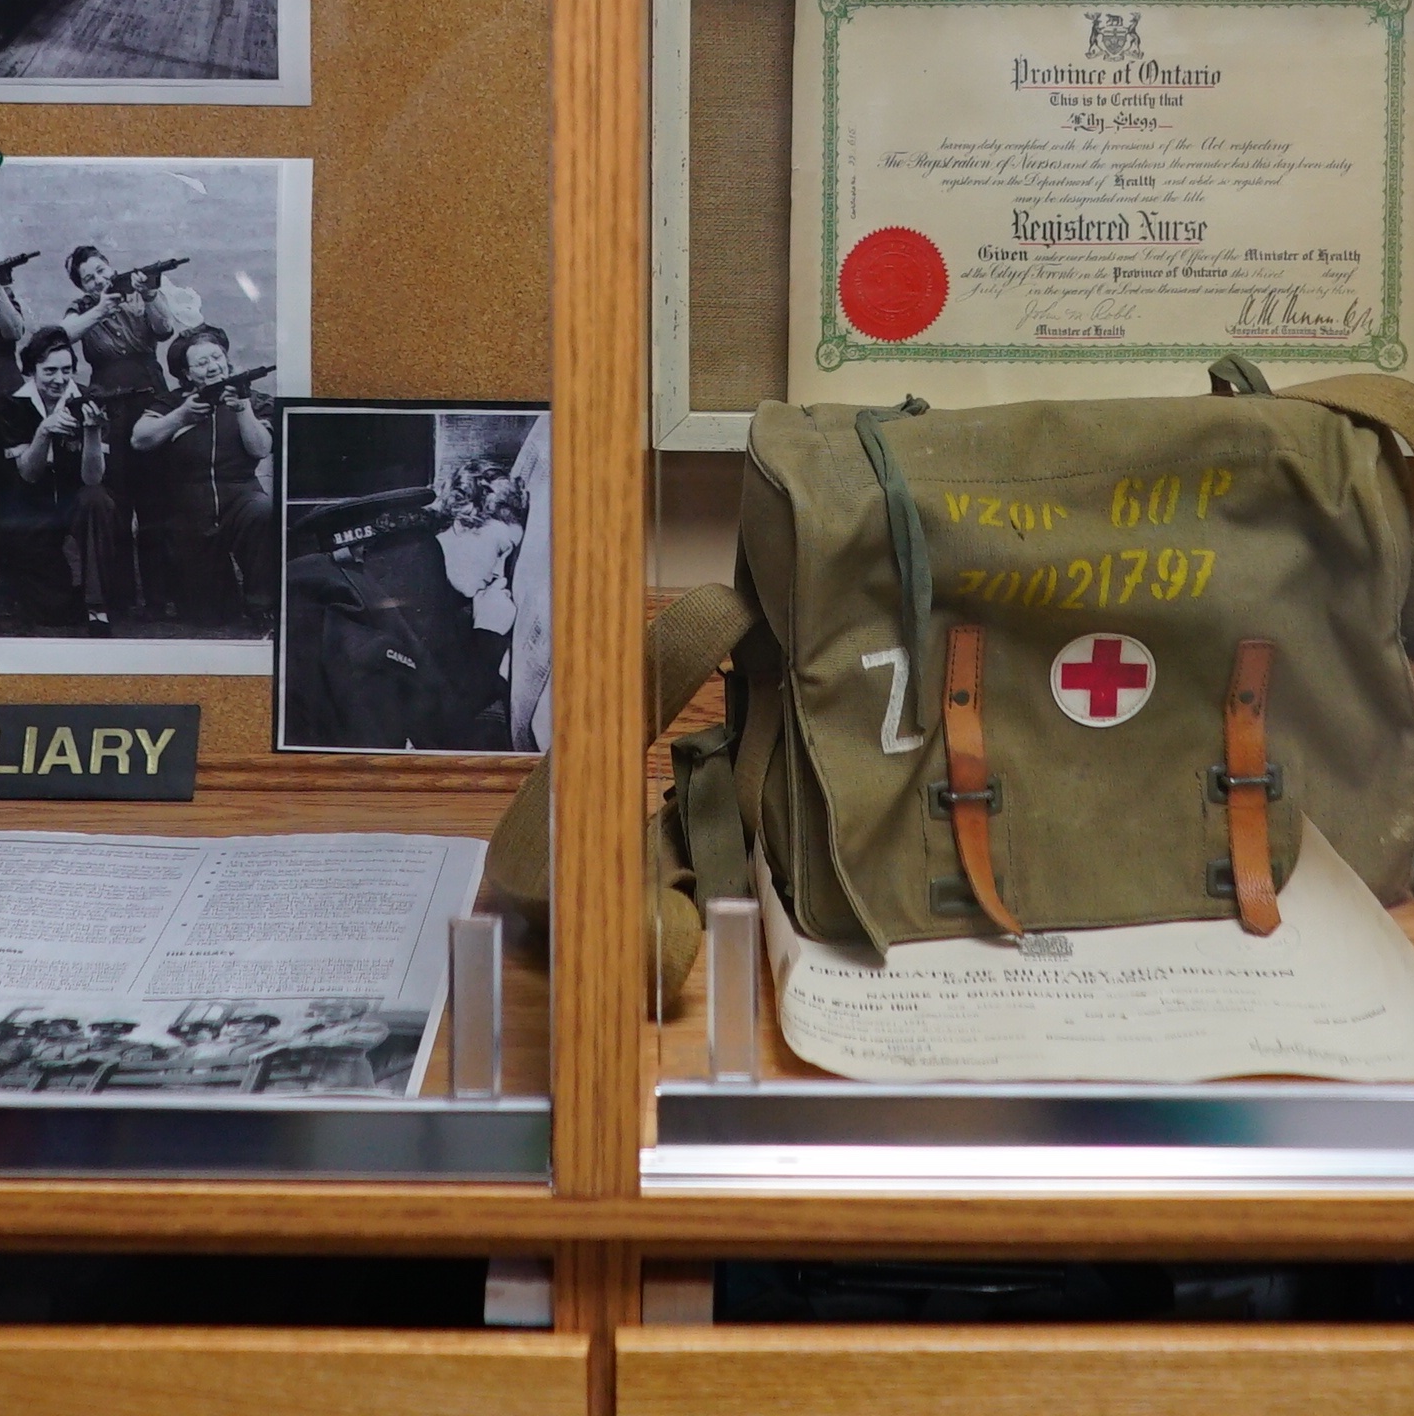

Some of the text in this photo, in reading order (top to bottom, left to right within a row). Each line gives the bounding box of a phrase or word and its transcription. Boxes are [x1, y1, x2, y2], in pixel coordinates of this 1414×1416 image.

[1010, 54, 1222, 91] Province of Ontario
[1049, 92, 1183, 109] This is to Certify that
[1114, 175, 1157, 189] Health
[1011, 208, 1209, 249] Registered Nurse
[978, 244, 1362, 265] Given Minister of Health
[1112, 266, 1229, 283] Province of Ontario
[1034, 324, 1081, 337] Minister
[1093, 324, 1126, 338] Health
